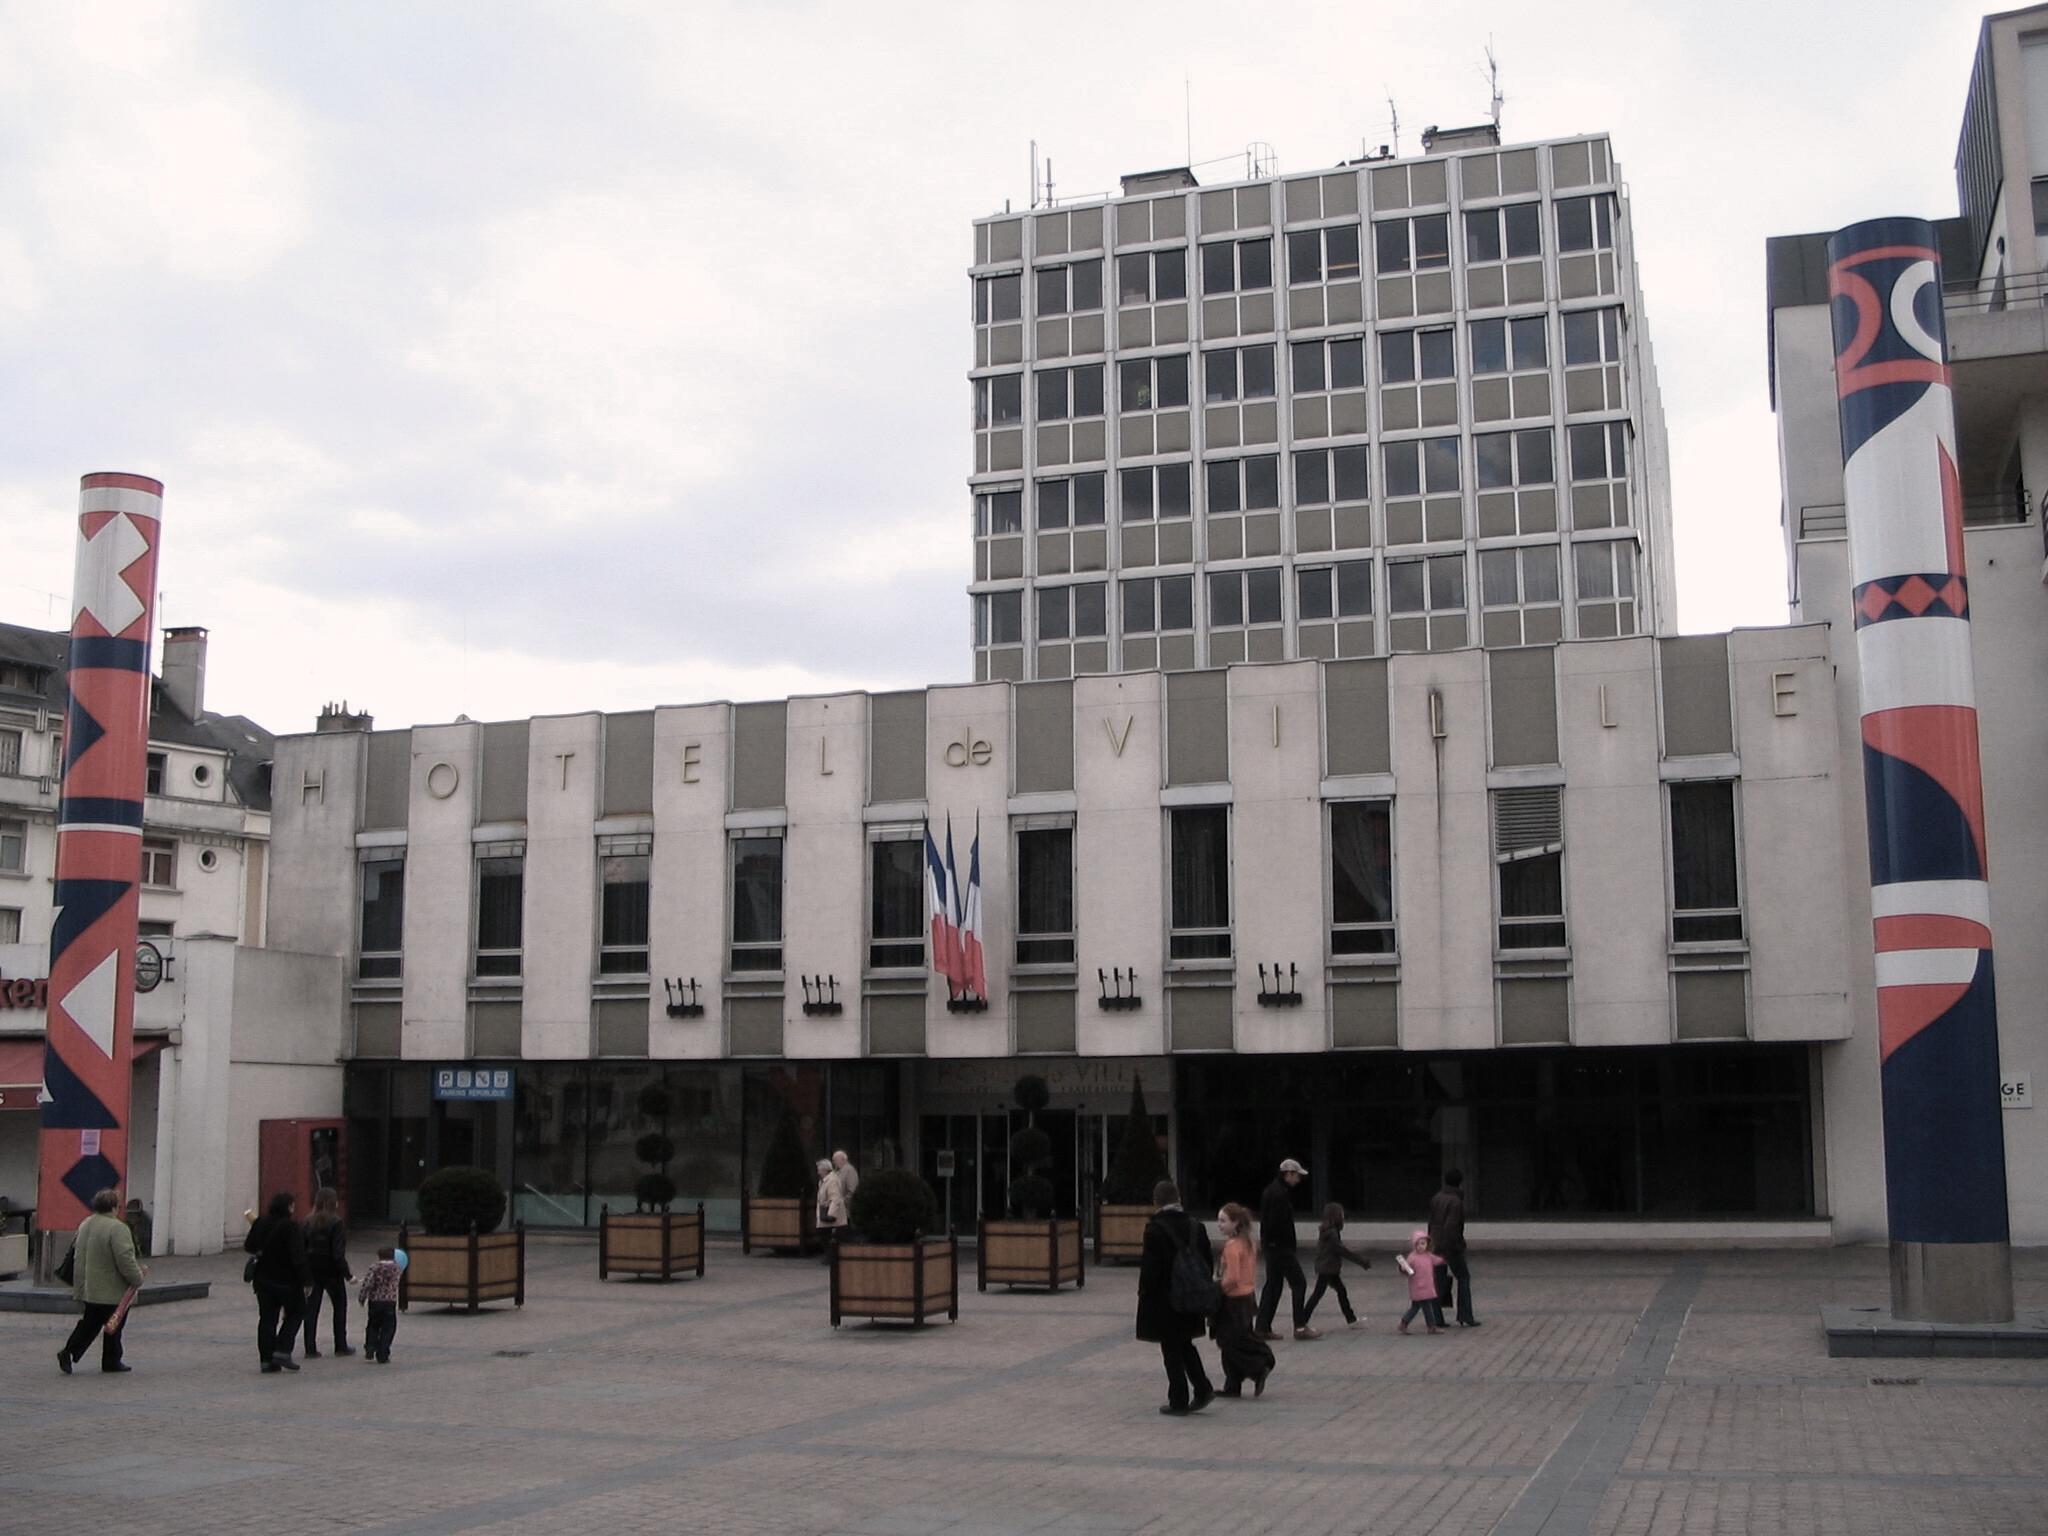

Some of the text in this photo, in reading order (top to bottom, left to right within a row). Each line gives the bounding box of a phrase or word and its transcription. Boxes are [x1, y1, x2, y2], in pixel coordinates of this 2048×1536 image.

[301, 671, 1798, 806] HOTEL de VILLE
[2001, 1083, 2024, 1095] GE
